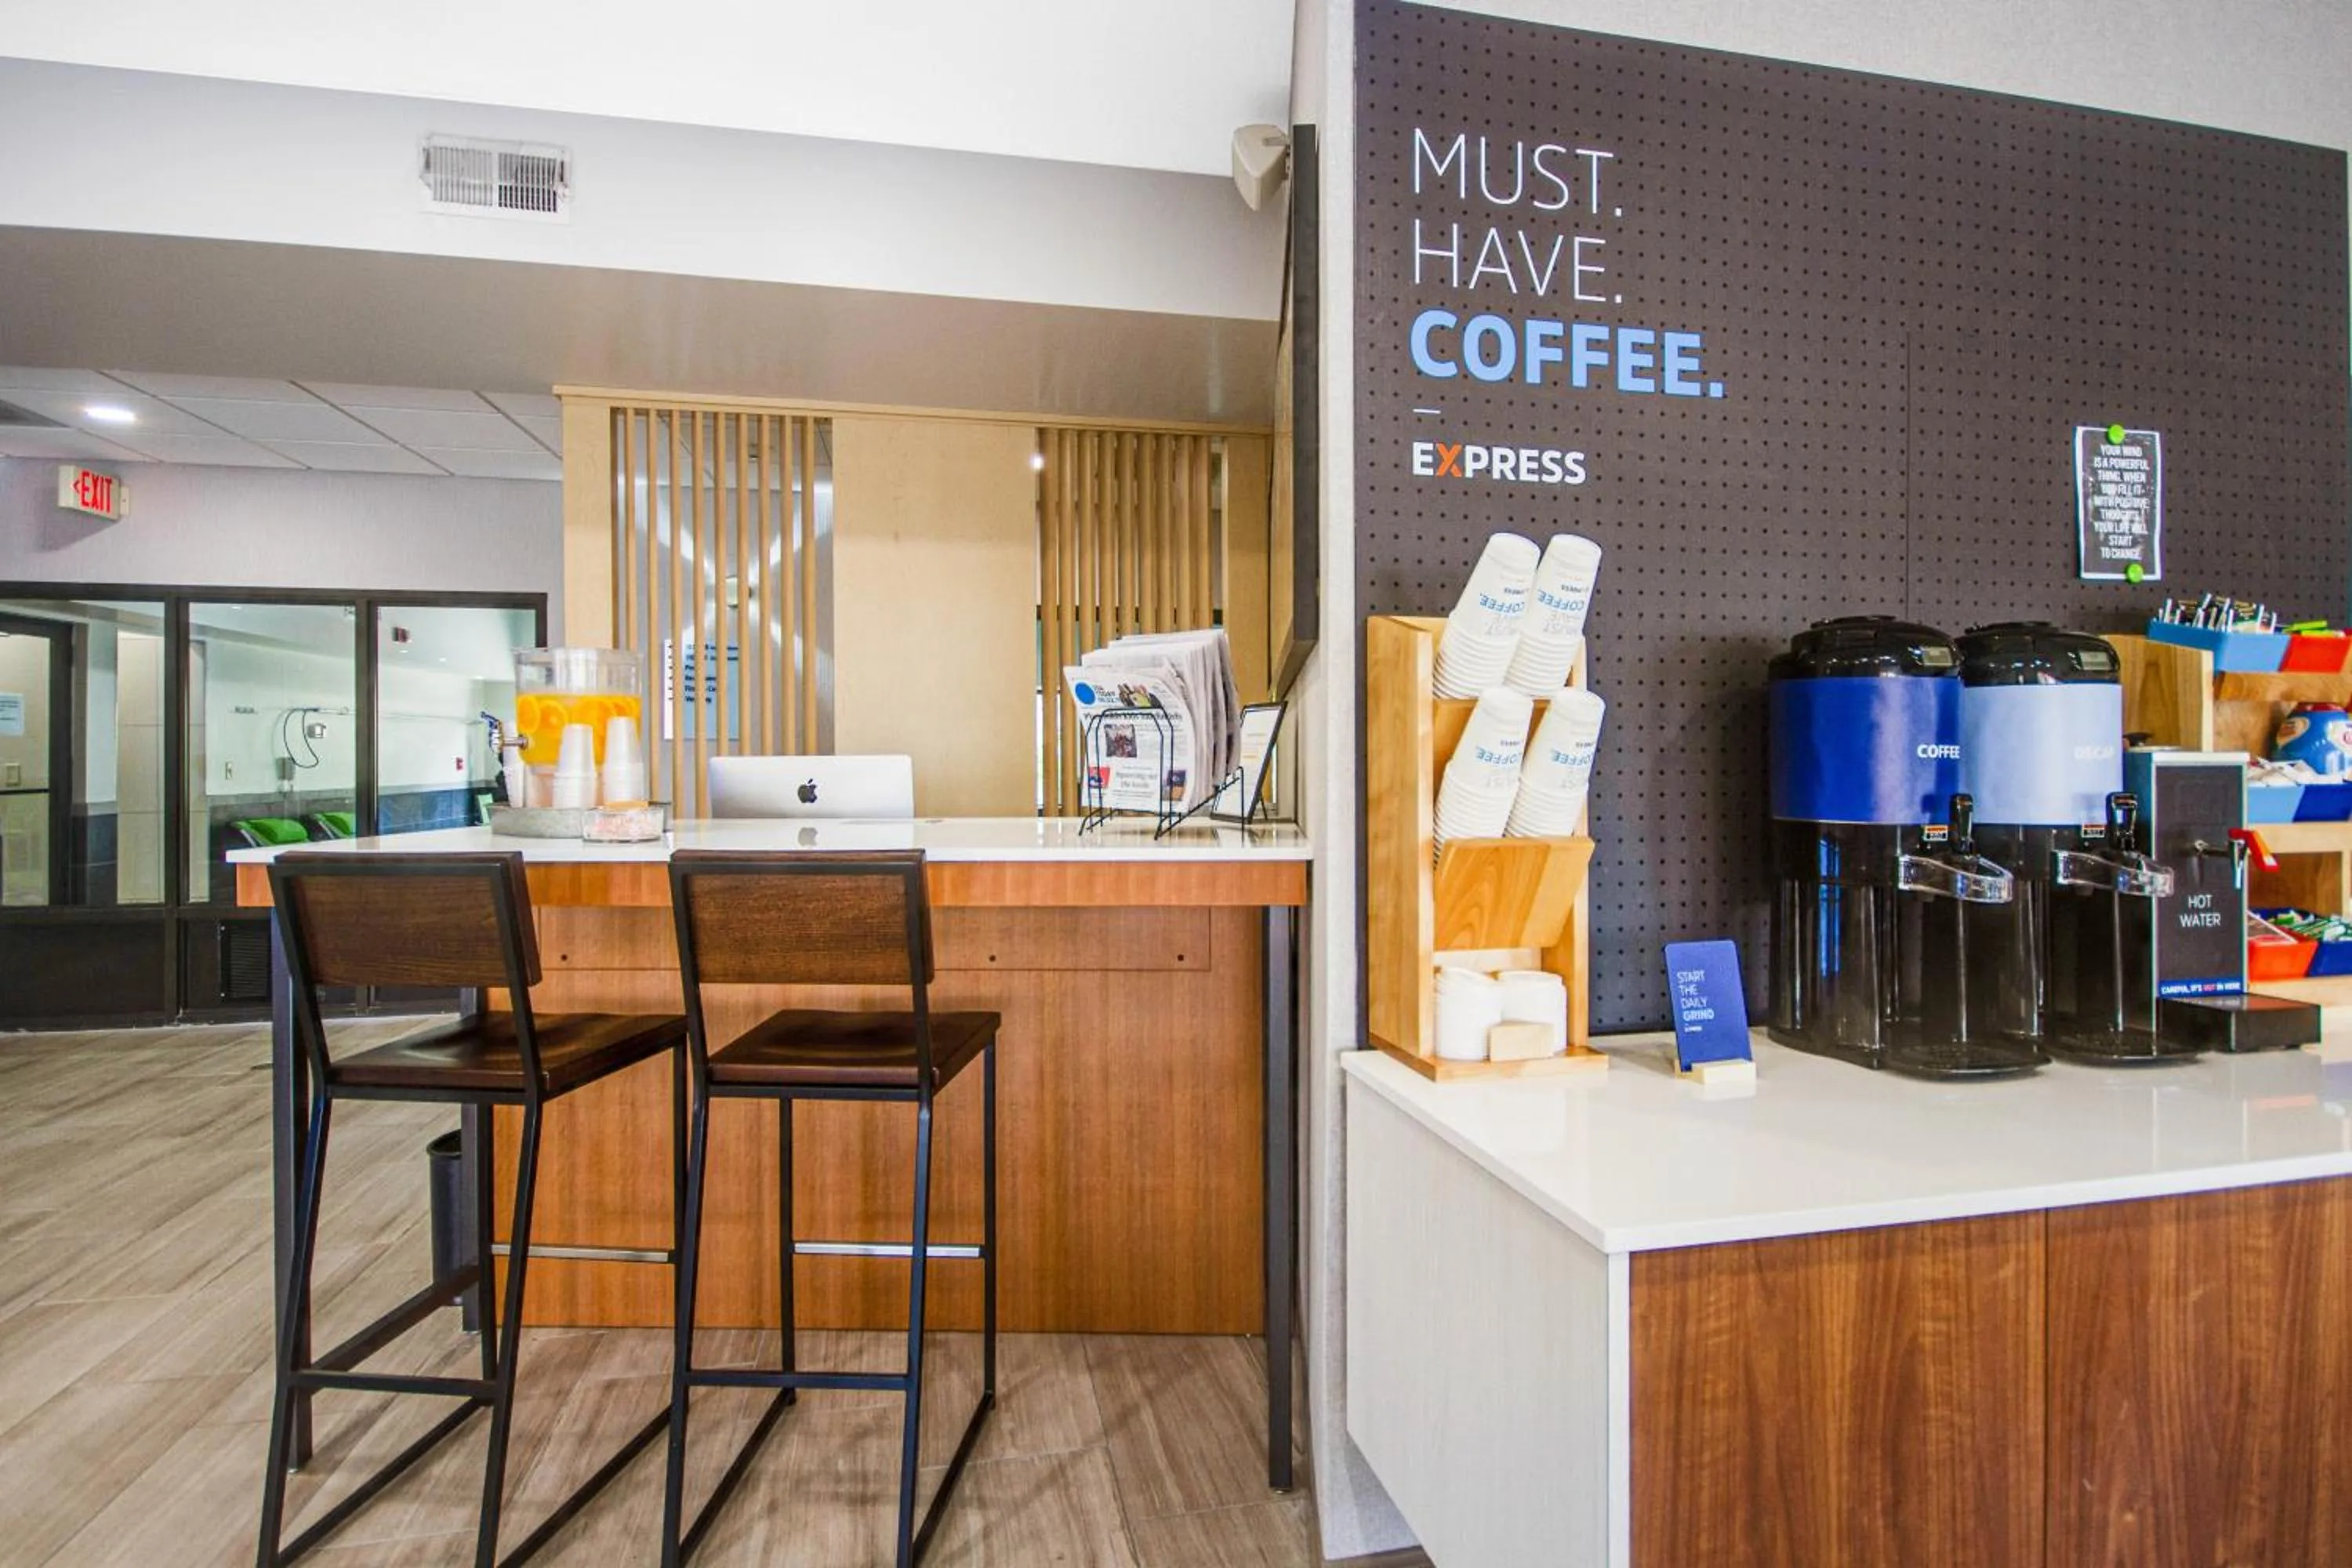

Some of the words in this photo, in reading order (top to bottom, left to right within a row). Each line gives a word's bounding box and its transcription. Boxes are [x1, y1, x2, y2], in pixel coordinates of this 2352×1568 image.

[1414, 128, 1623, 217] MUST.
[1414, 219, 1623, 304] HAVE.
[1410, 309, 1725, 399] COFFEE.
[1412, 441, 1587, 485] EXPRESS
[81, 470, 112, 514] EXIT
[2108, 535, 2132, 546] START
[1917, 744, 1960, 759] COFFEE
[2188, 895, 2212, 909] HOT
[2179, 913, 2221, 928] WATER
[1677, 970, 1704, 983] START
[1678, 984, 1698, 996] THE
[1681, 996, 1708, 1009] DAILY
[1682, 1009, 1715, 1022] GRIND
